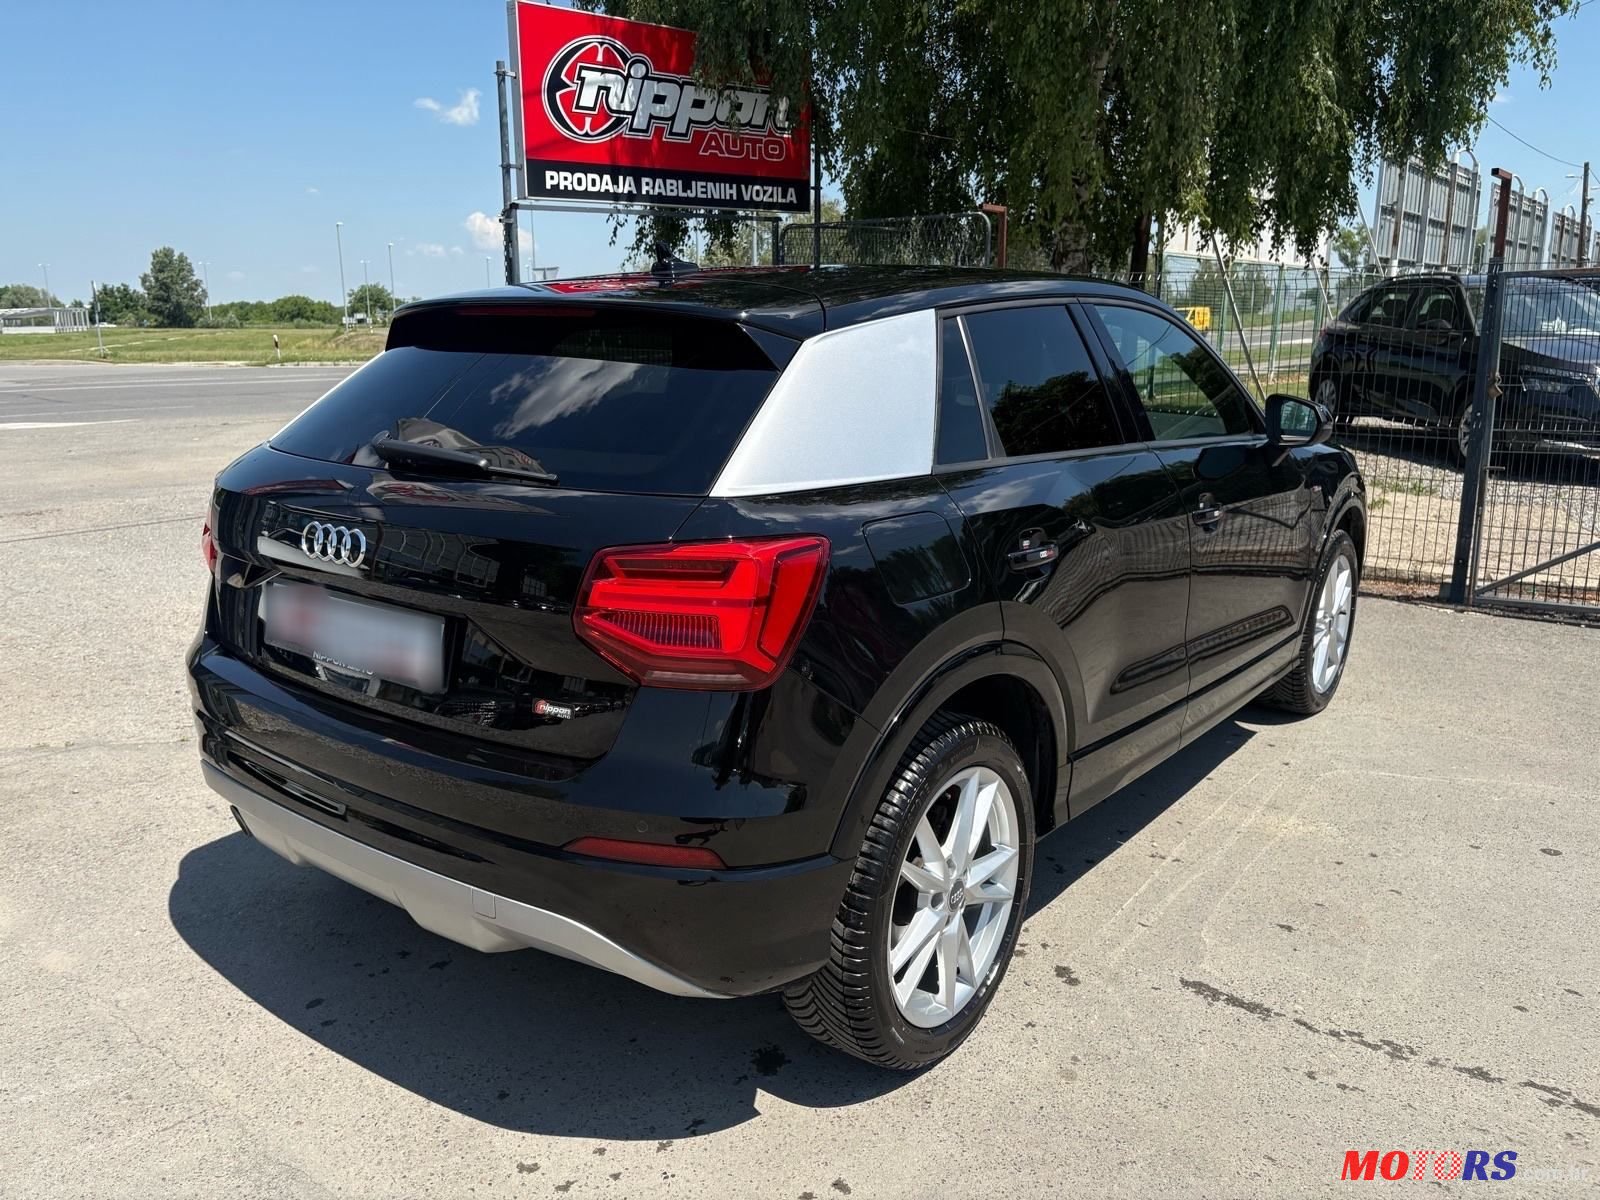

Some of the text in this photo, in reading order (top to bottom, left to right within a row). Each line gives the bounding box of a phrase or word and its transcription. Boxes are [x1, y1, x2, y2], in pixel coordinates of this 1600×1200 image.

[699, 132, 786, 161] AUTO
[545, 170, 798, 204] PRODAJA RABLJENIH VOZILA
